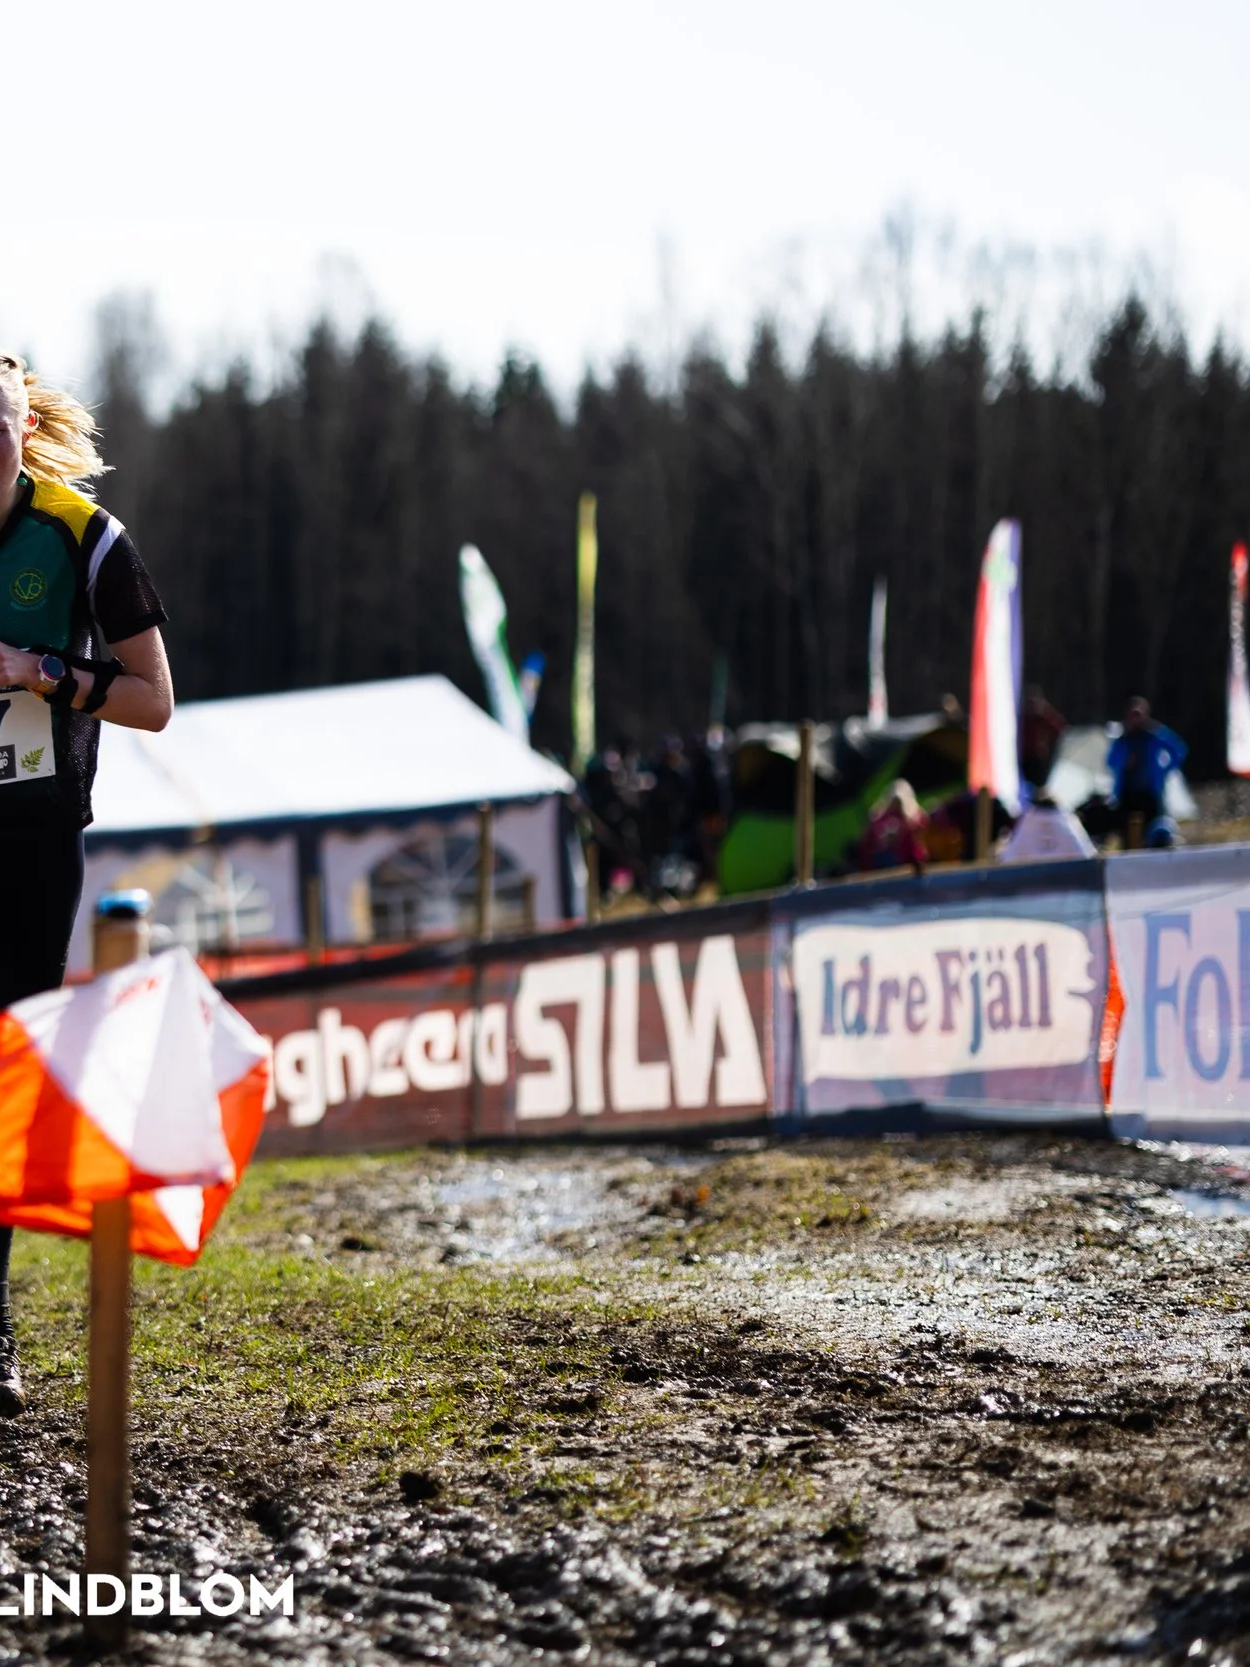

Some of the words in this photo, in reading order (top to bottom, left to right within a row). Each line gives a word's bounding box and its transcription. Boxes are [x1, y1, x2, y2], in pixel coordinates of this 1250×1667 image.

[515, 934, 768, 1119] SILVA
[820, 954, 928, 1037] Idre
[935, 943, 1054, 1057] Fjäll
